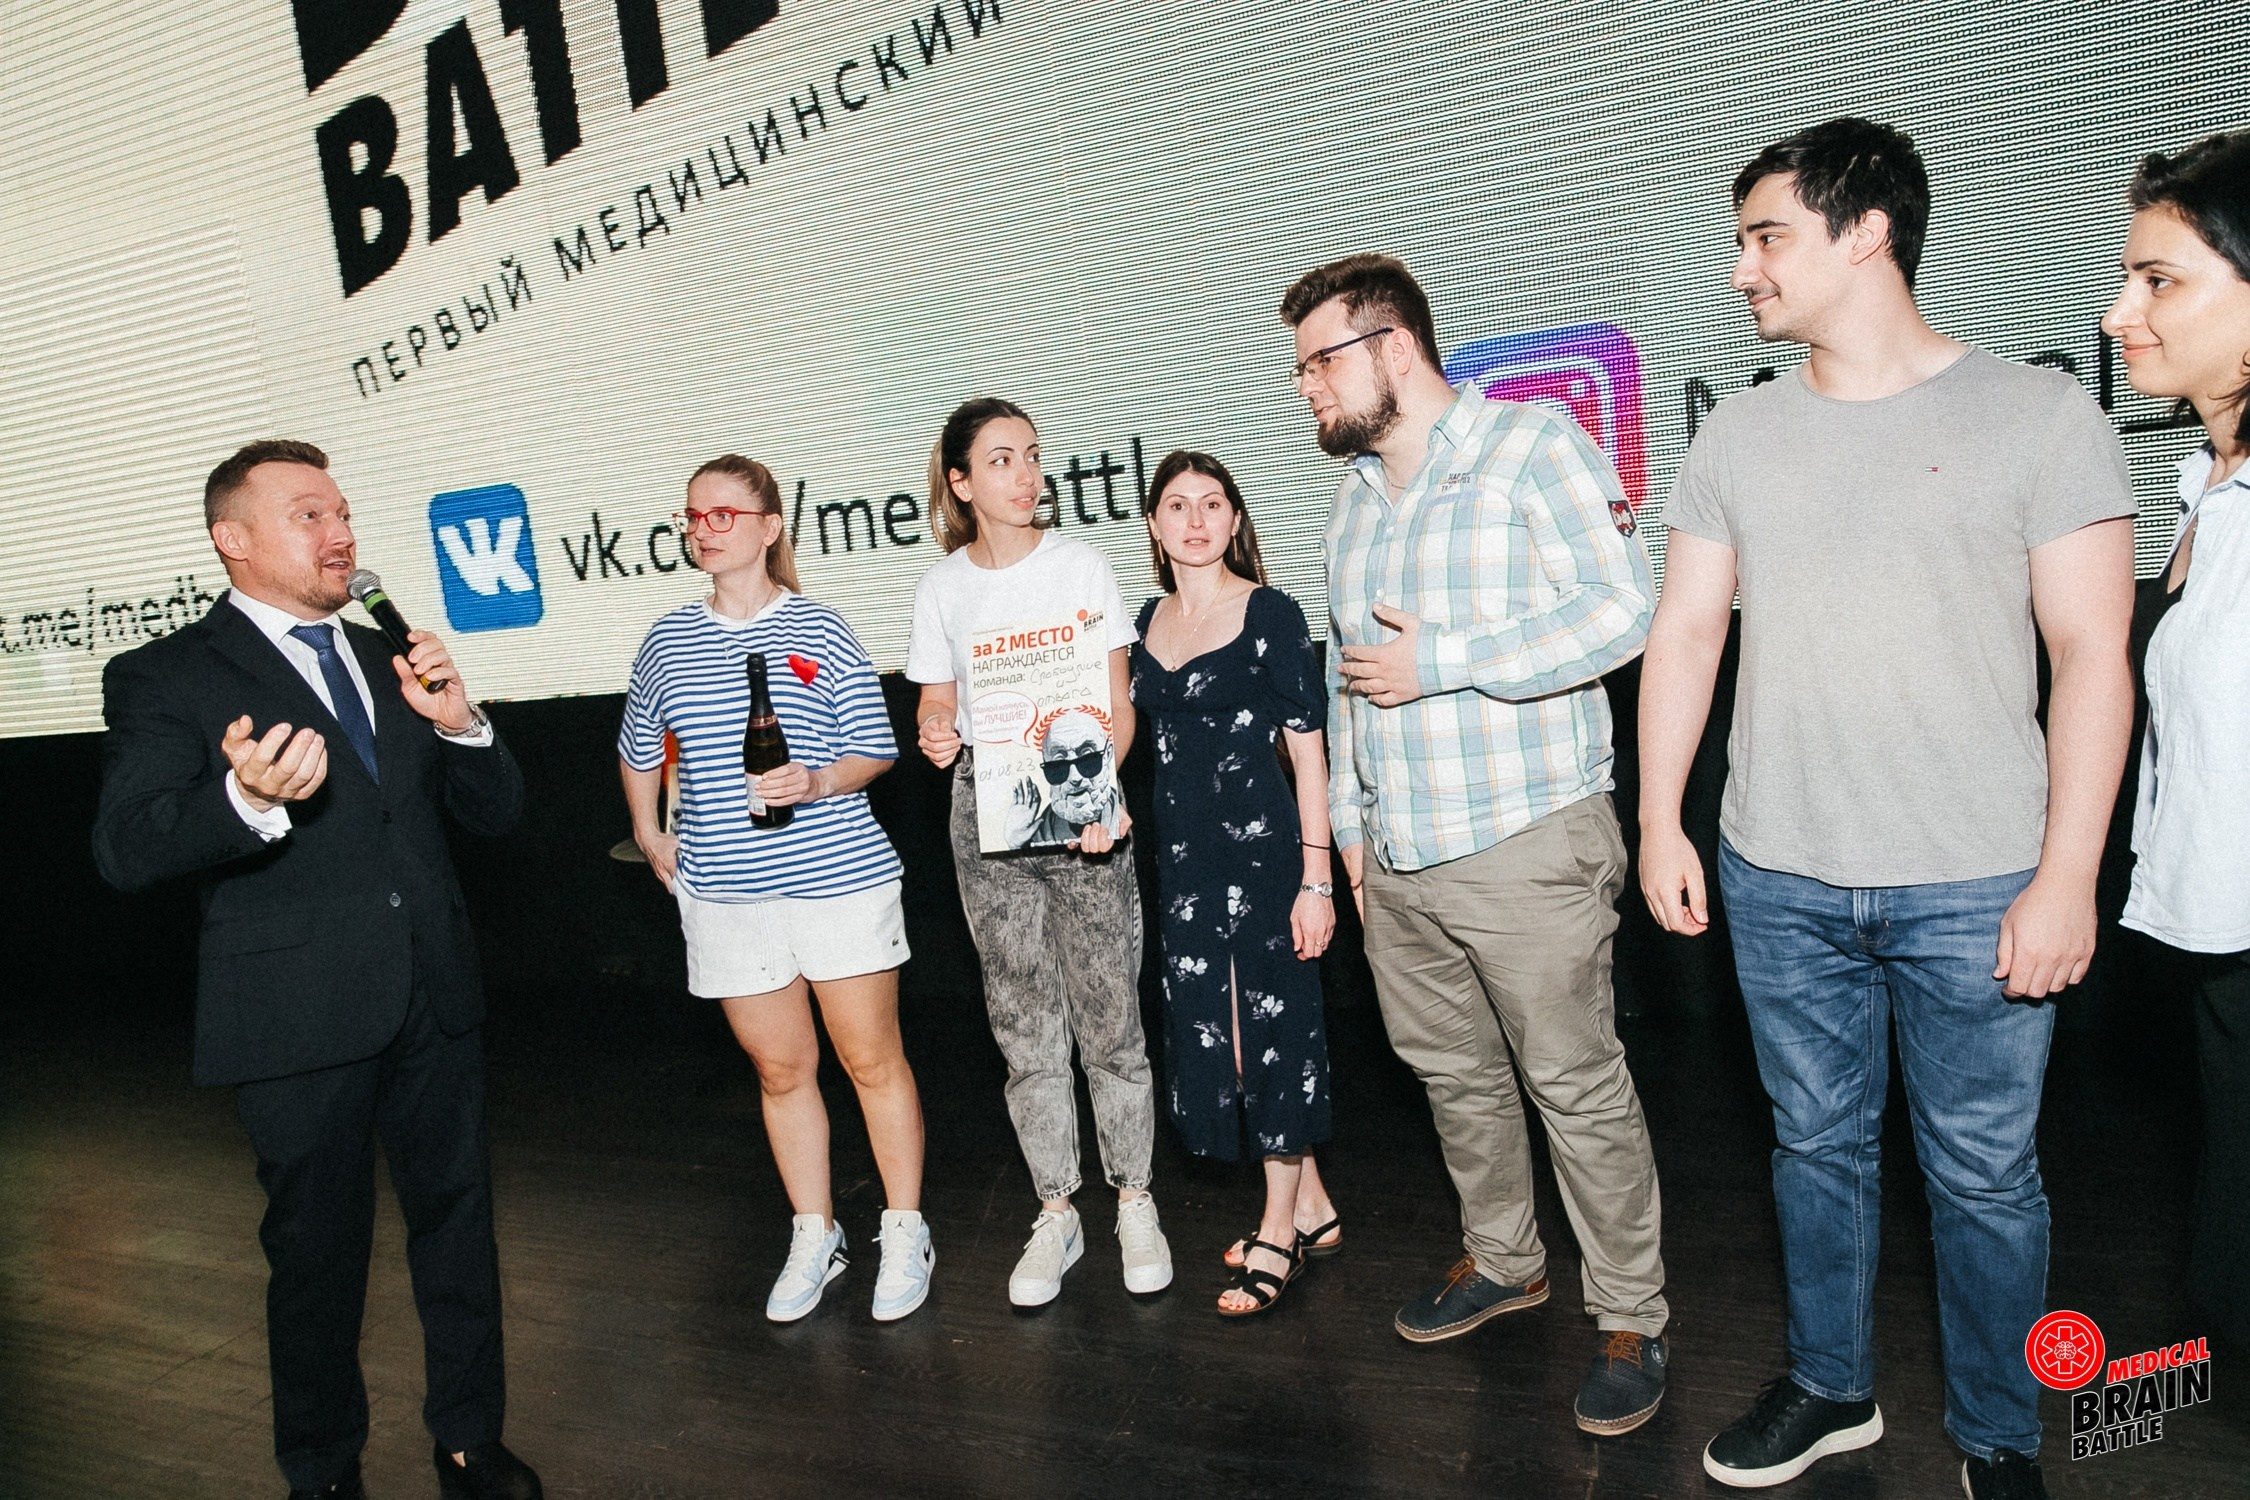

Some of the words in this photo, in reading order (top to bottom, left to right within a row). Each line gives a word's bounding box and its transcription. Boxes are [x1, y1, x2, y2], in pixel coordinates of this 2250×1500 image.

[352, 255, 534, 398] ПЕРВЫЙ
[973, 643, 993, 658] за
[995, 636, 1006, 654] 2
[1009, 625, 1074, 651] МЕСТО
[972, 646, 1075, 674] НАГРАЖДАЕТСЯ
[973, 673, 1026, 689] команда:
[984, 709, 1027, 725] ЛУЧШИЕ!
